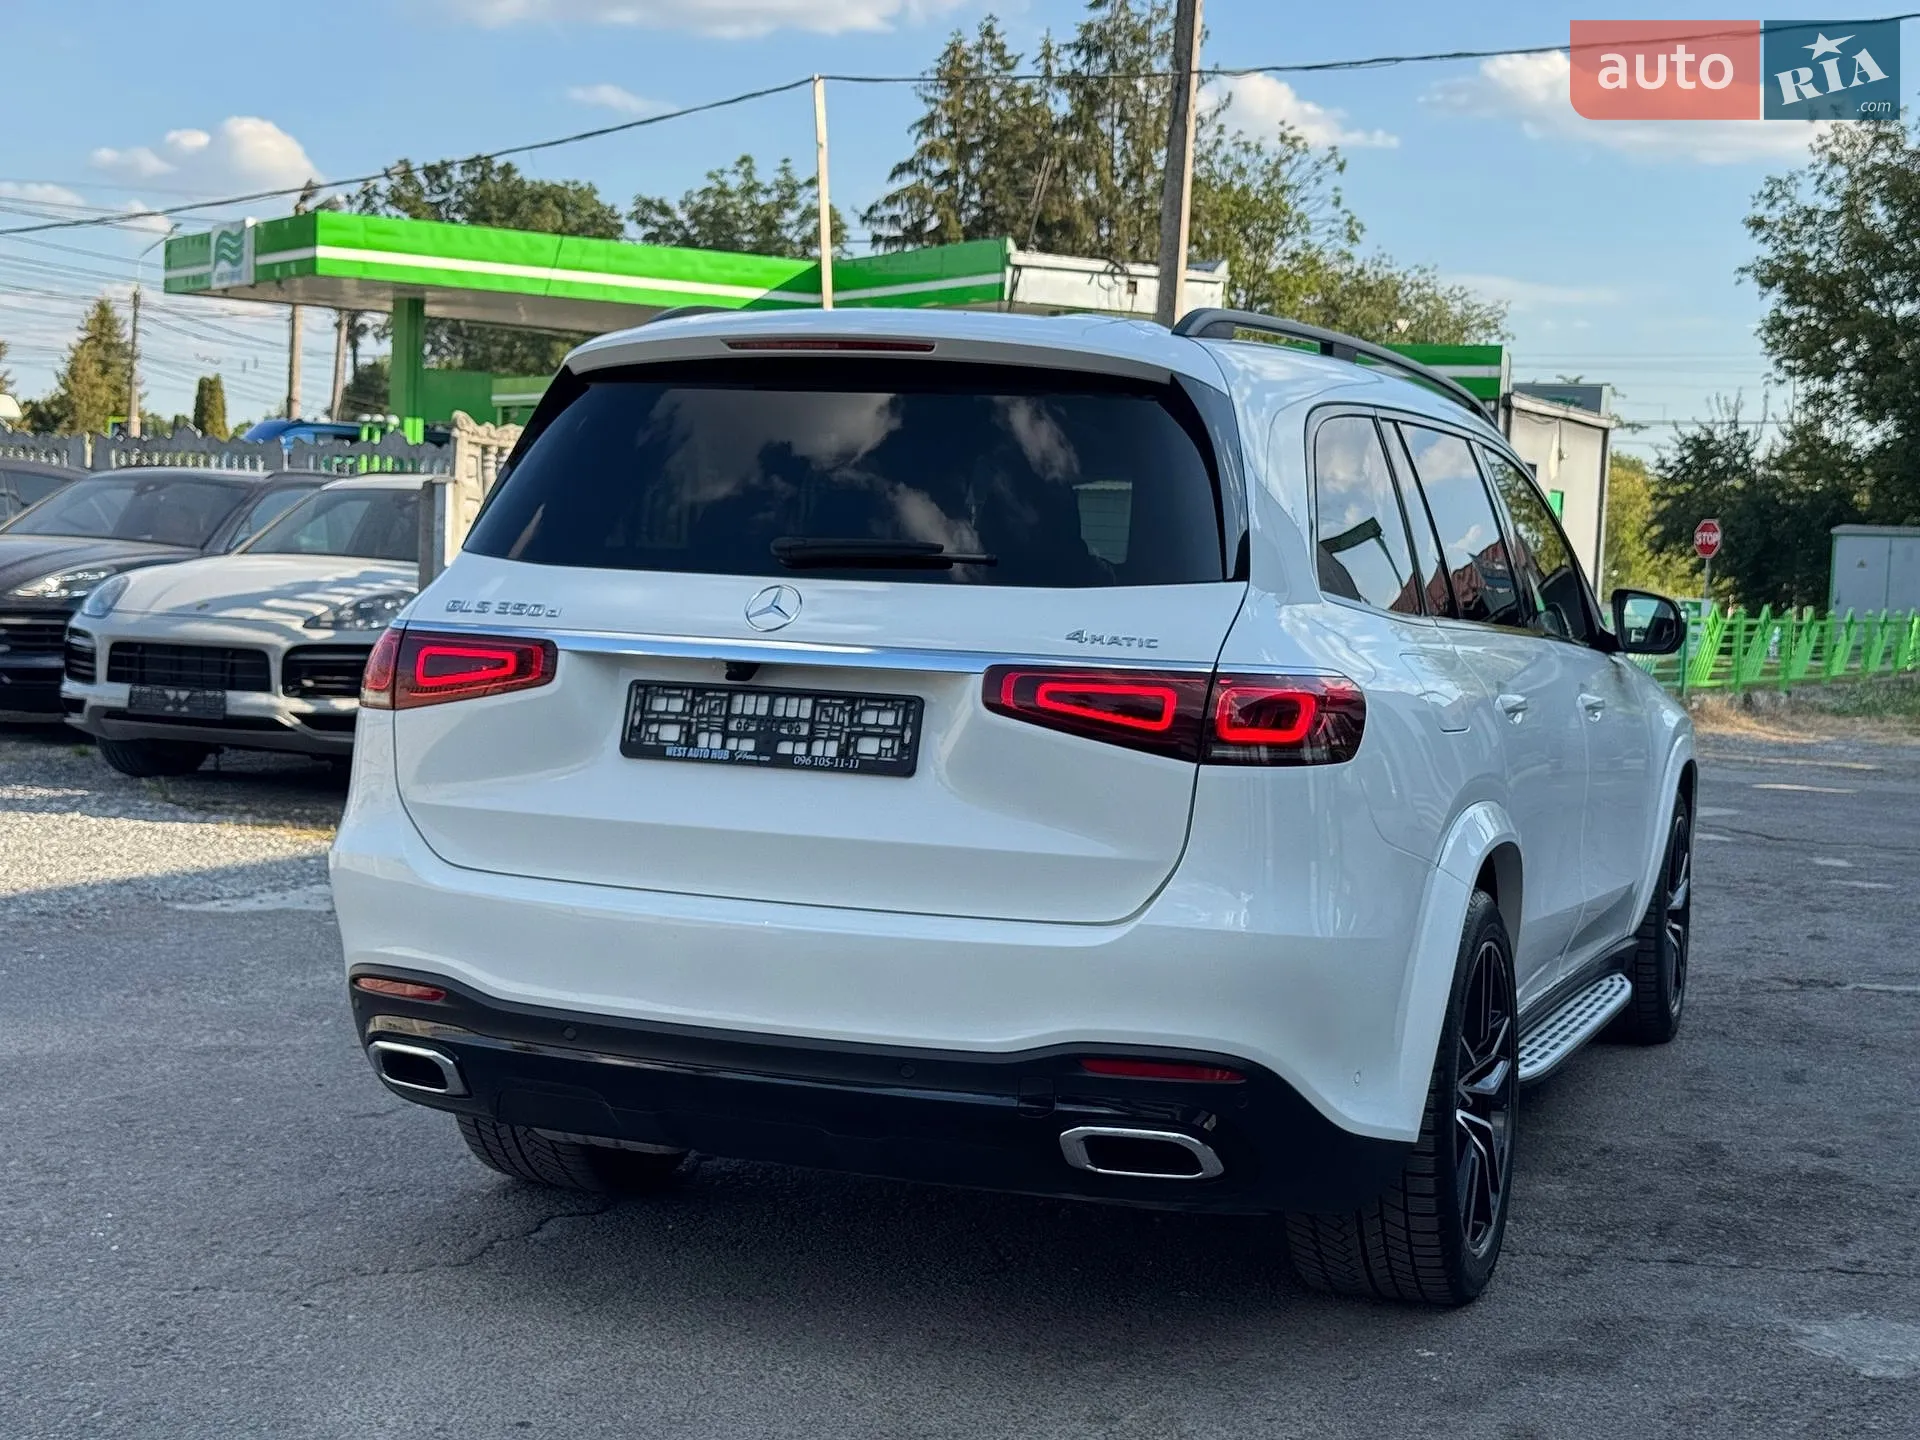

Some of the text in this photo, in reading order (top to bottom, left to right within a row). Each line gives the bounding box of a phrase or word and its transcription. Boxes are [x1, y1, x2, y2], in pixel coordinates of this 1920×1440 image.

[1696, 531, 1720, 545] STOP
[445, 600, 492, 614] GLS
[1065, 629, 1159, 649] 4MATIC
[665, 746, 688, 758] WEST
[687, 747, 710, 759] AUTO
[710, 749, 730, 760] HUB
[793, 755, 860, 769] 096 105-11-11
